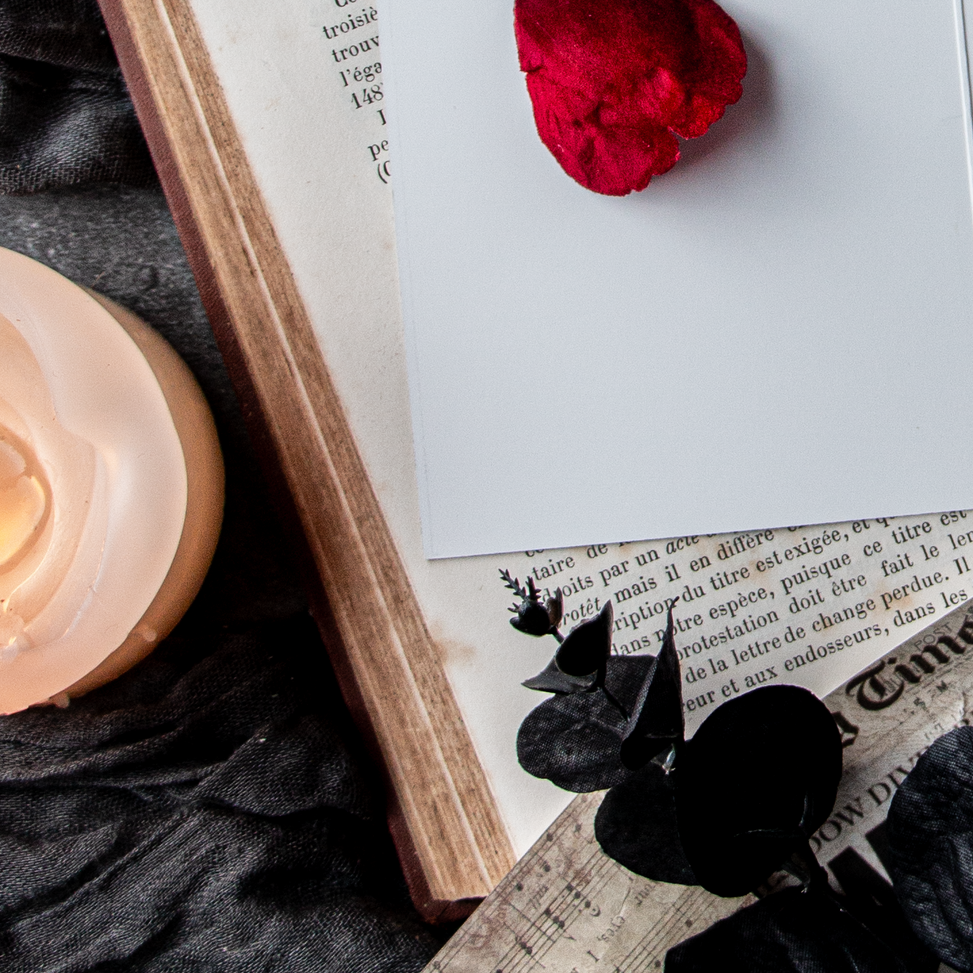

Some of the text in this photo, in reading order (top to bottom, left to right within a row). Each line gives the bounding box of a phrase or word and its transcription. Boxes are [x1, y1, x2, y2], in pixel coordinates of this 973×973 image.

[323, 6, 378, 39] troisiè
[332, 36, 379, 62] trouv
[339, 62, 382, 87] l'éga
[351, 82, 384, 109] 148
[532, 557, 575, 581] taire
[599, 560, 629, 587] par
[635, 550, 660, 566] un
[612, 598, 678, 634] ription
[682, 585, 706, 602] du
[710, 567, 750, 590] titre
[756, 551, 782, 572] est
[784, 530, 849, 561] exigée,
[614, 529, 775, 603] mais il en diffère
[709, 588, 775, 619] espèce,
[780, 554, 851, 595] puisque
[863, 541, 883, 557] ce
[892, 521, 932, 544] titre
[789, 589, 825, 614] doit
[832, 575, 867, 596] être
[881, 553, 914, 577] fait
[920, 544, 939, 561] le
[685, 667, 707, 684] de
[708, 658, 729, 675] la
[730, 637, 781, 665] lettre
[784, 626, 806, 643] de
[812, 599, 876, 632] change
[880, 572, 949, 610] perdue.
[721, 679, 740, 698] et
[745, 664, 778, 687] aux
[784, 624, 889, 671] endosseurs,
[893, 603, 935, 627] dans
[941, 589, 969, 608] les
